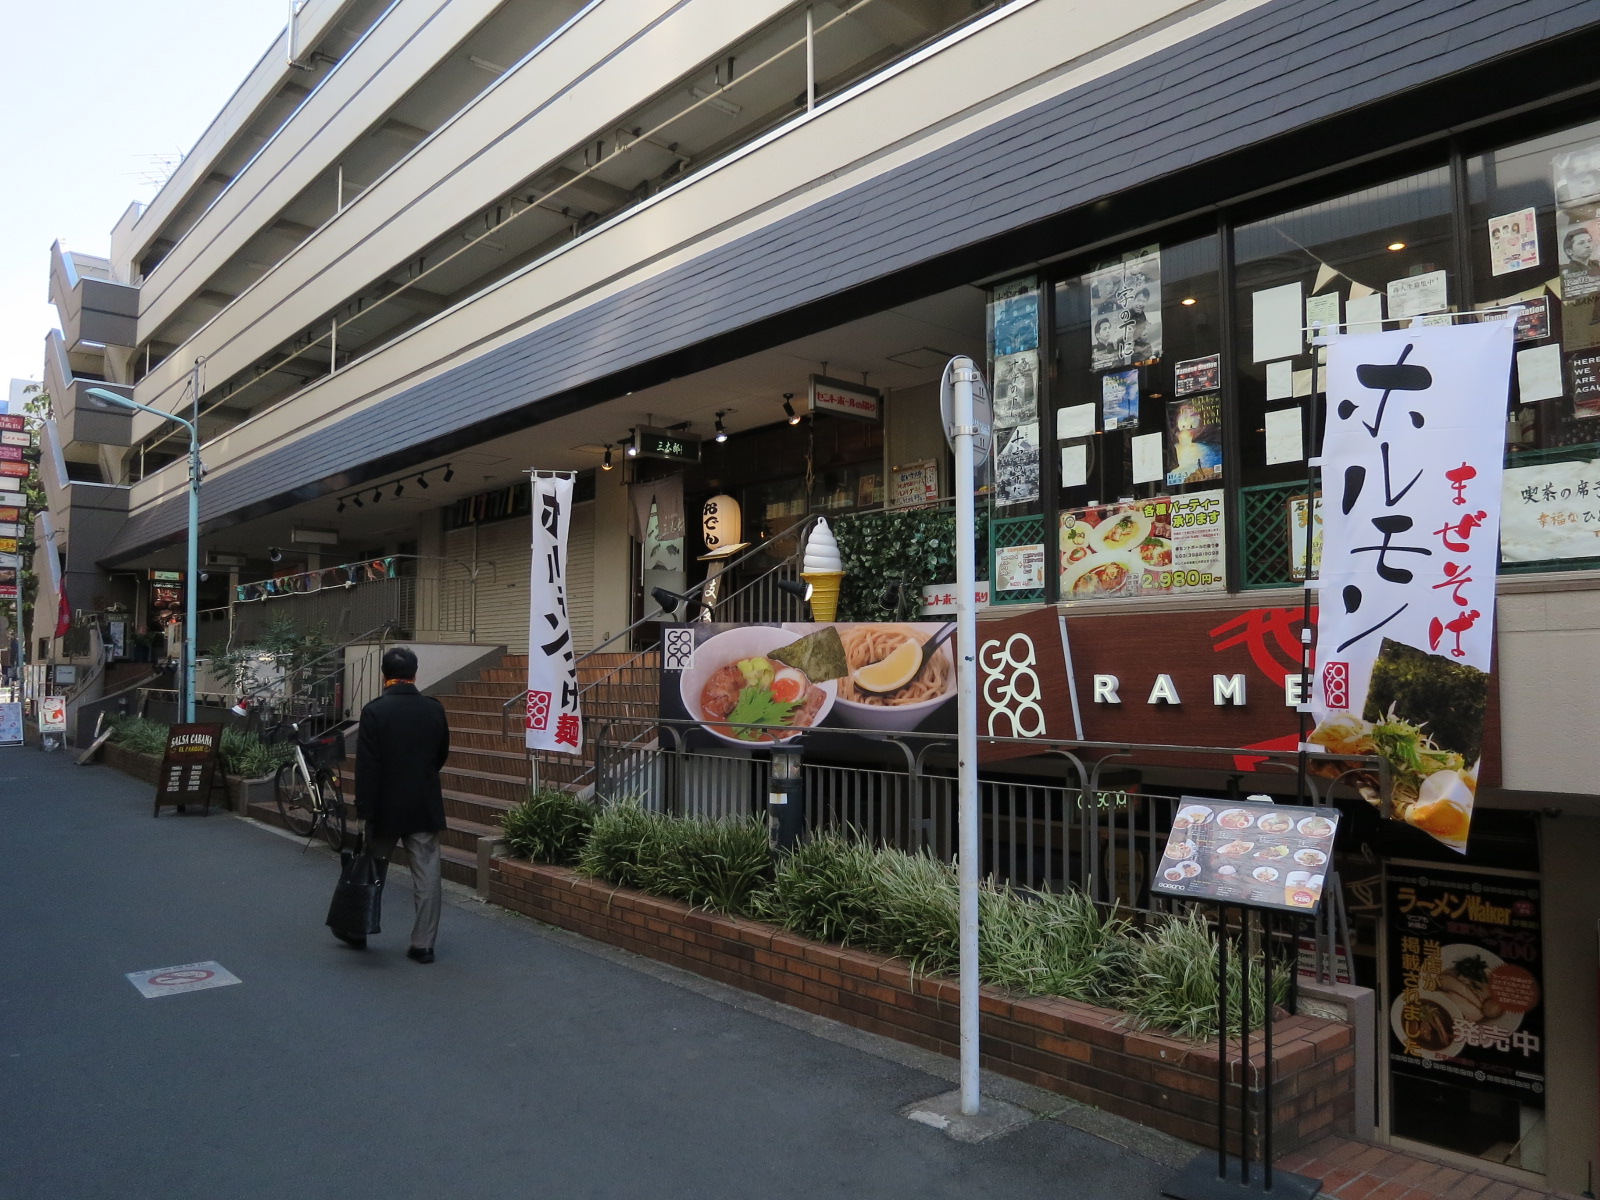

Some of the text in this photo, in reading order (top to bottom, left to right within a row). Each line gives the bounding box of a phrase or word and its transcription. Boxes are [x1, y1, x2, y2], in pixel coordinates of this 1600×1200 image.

[1573, 367, 1591, 376] WE
[1575, 376, 1597, 385] ARE
[1143, 498, 1220, 518] 各種パーティー
[1338, 343, 1432, 653] ホルモン
[703, 502, 720, 546] おでん
[1172, 510, 1220, 528] 承ります
[1429, 462, 1488, 658] まぜそば
[171, 733, 213, 748] SALSA CABANA
[1421, 939, 1442, 992] 当店が
[1400, 935, 1422, 1057] 掲載されました
[1451, 1018, 1541, 1057] 発売中
